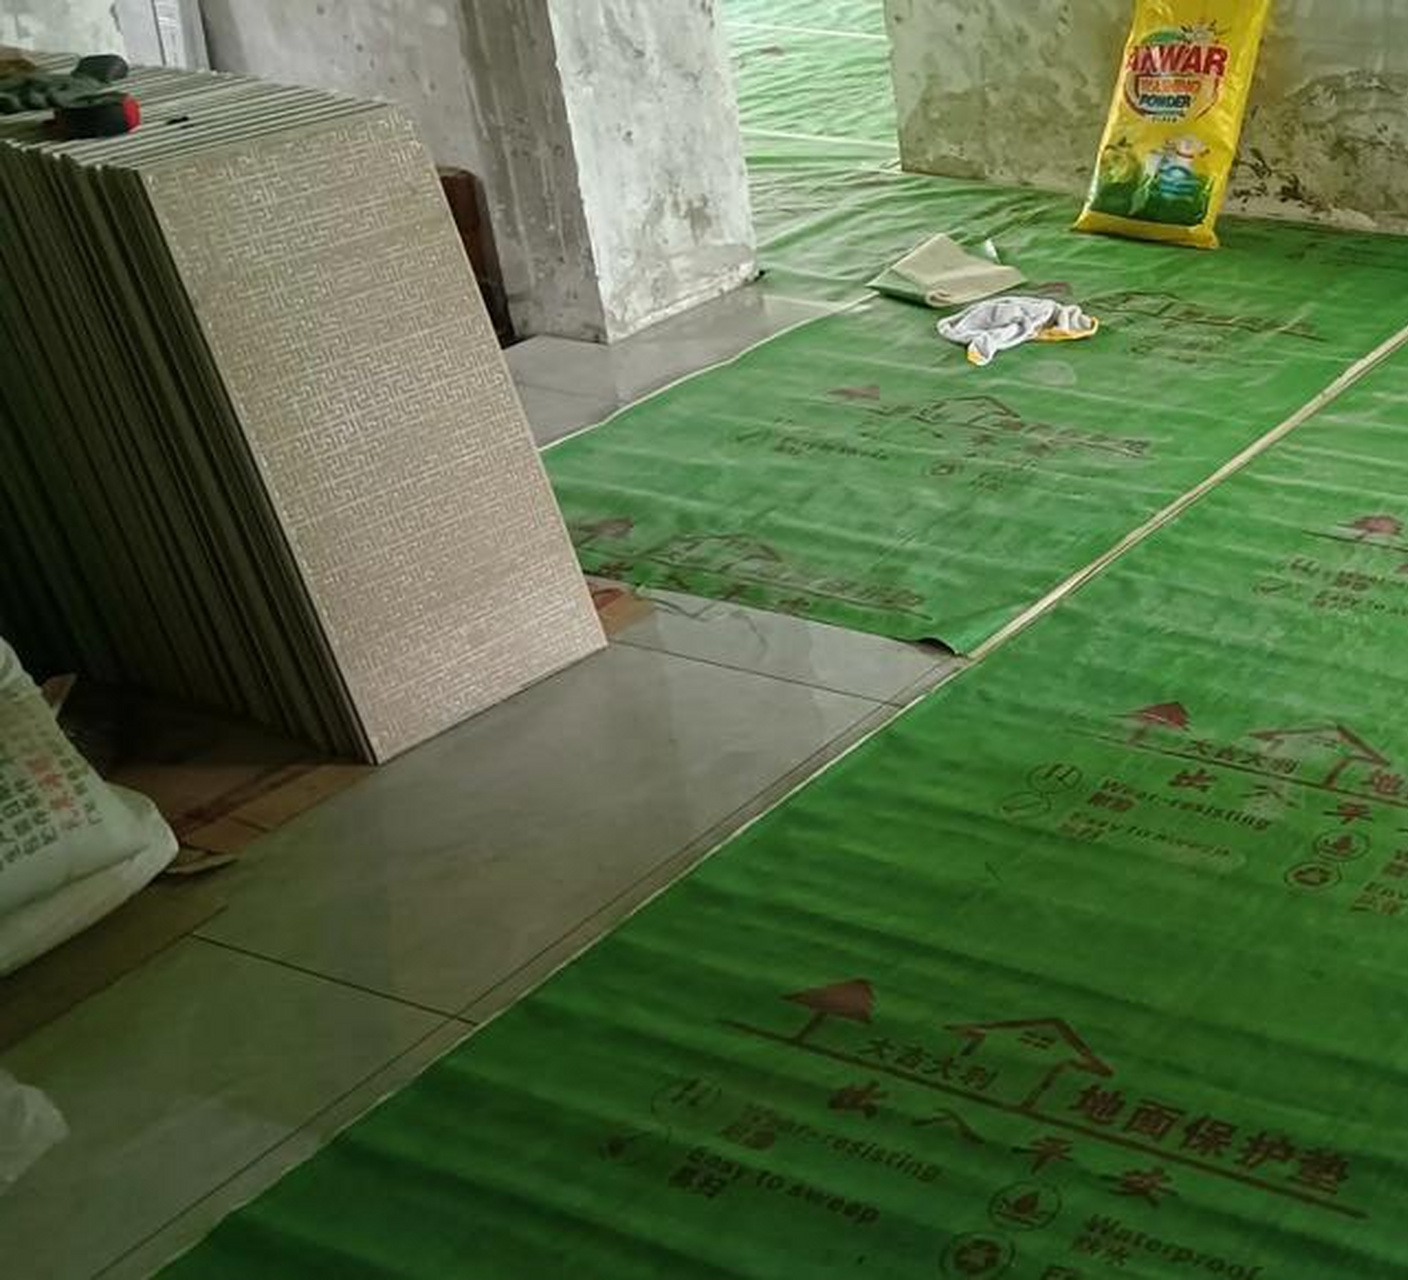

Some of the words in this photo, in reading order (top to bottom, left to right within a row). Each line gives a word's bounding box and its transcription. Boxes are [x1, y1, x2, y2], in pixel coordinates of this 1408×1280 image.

[1138, 94, 1192, 108] POWDER
[856, 1035, 999, 1092] 大吉大利
[1069, 1082, 1350, 1196] 地面保护垫
[1083, 1212, 1265, 1280] Waterproof
